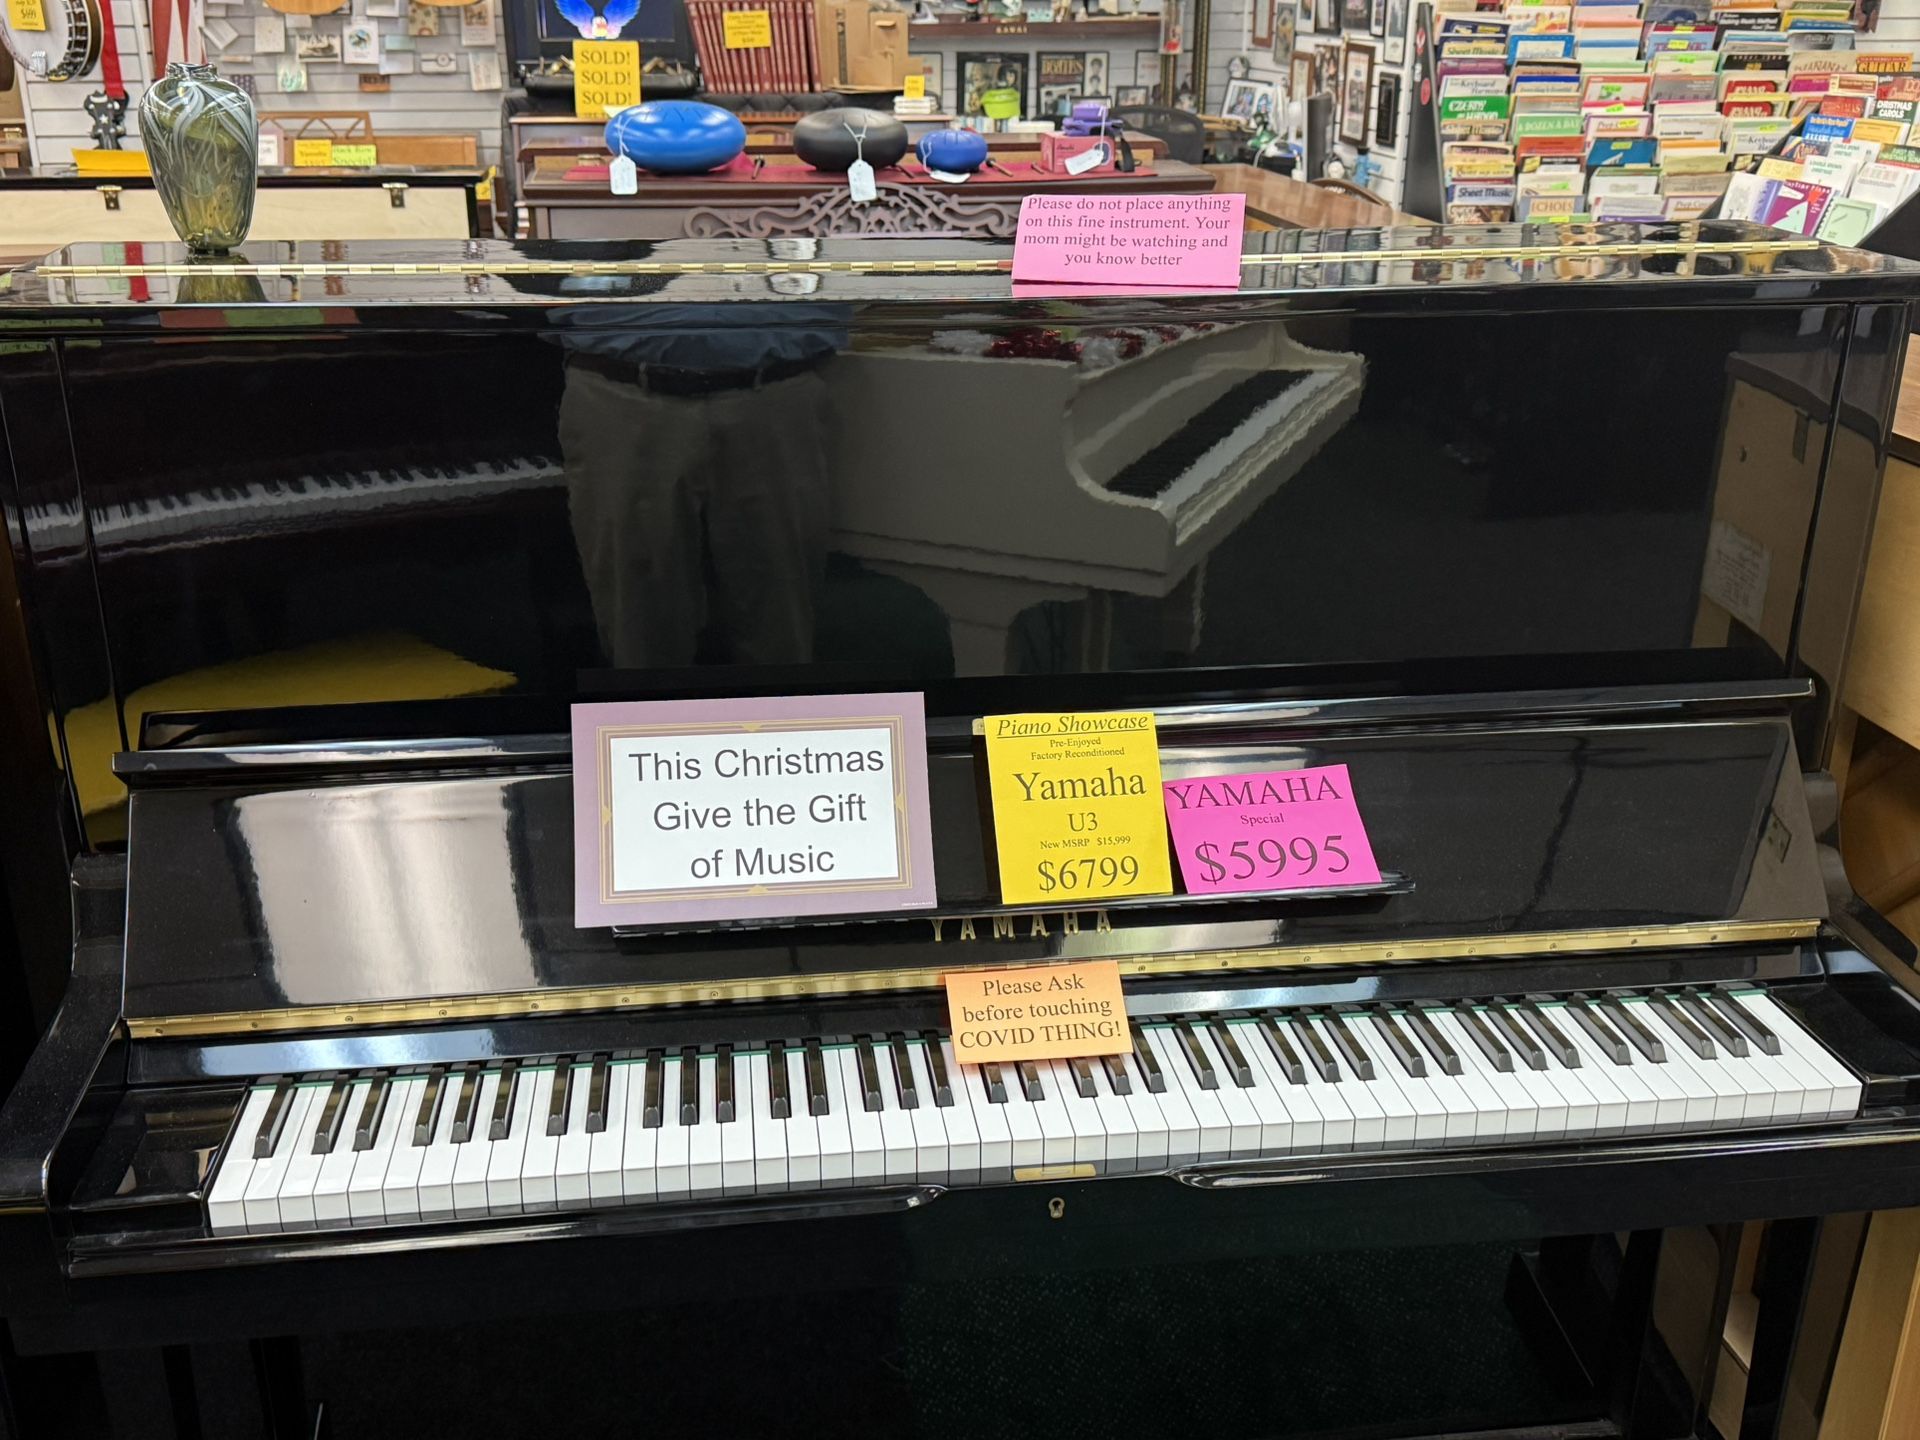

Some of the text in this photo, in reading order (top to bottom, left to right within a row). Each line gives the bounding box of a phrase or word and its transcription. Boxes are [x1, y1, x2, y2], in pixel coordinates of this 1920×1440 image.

[581, 50, 631, 65] SOLD!
[582, 71, 632, 85] SOLD!
[583, 91, 633, 106] SOLD!
[1877, 100, 1912, 111] CHRISTMAS
[1879, 109, 1905, 118] CAROLS
[1458, 187, 1512, 198] Sheet Music
[1028, 197, 1231, 213] Please do not place anything
[1025, 215, 1231, 229] on this fine instrument. Your
[1023, 233, 1228, 250] mom might be watching and
[1064, 252, 1183, 266] you know better
[997, 715, 1148, 737] Piano Showcase
[1050, 737, 1101, 748] Pre-Enjoyed
[1031, 747, 1125, 761] Factory Reconditioned
[628, 747, 885, 782] This Christmas
[1012, 767, 1147, 802] Yamaha
[1165, 775, 1344, 810] YAMAHA
[653, 793, 867, 831] Give the Gift
[1240, 813, 1285, 827] Special
[1067, 812, 1098, 832] U3
[1040, 835, 1131, 849] New MSRP $15,999
[690, 845, 835, 879] of Music
[1194, 835, 1350, 885] $5995
[1038, 855, 1139, 894] $6799
[931, 910, 1112, 942] YAMAHA
[983, 973, 1085, 997] Please Ask
[962, 998, 1112, 1023] before touching
[960, 1020, 1121, 1049] COVID THING!
